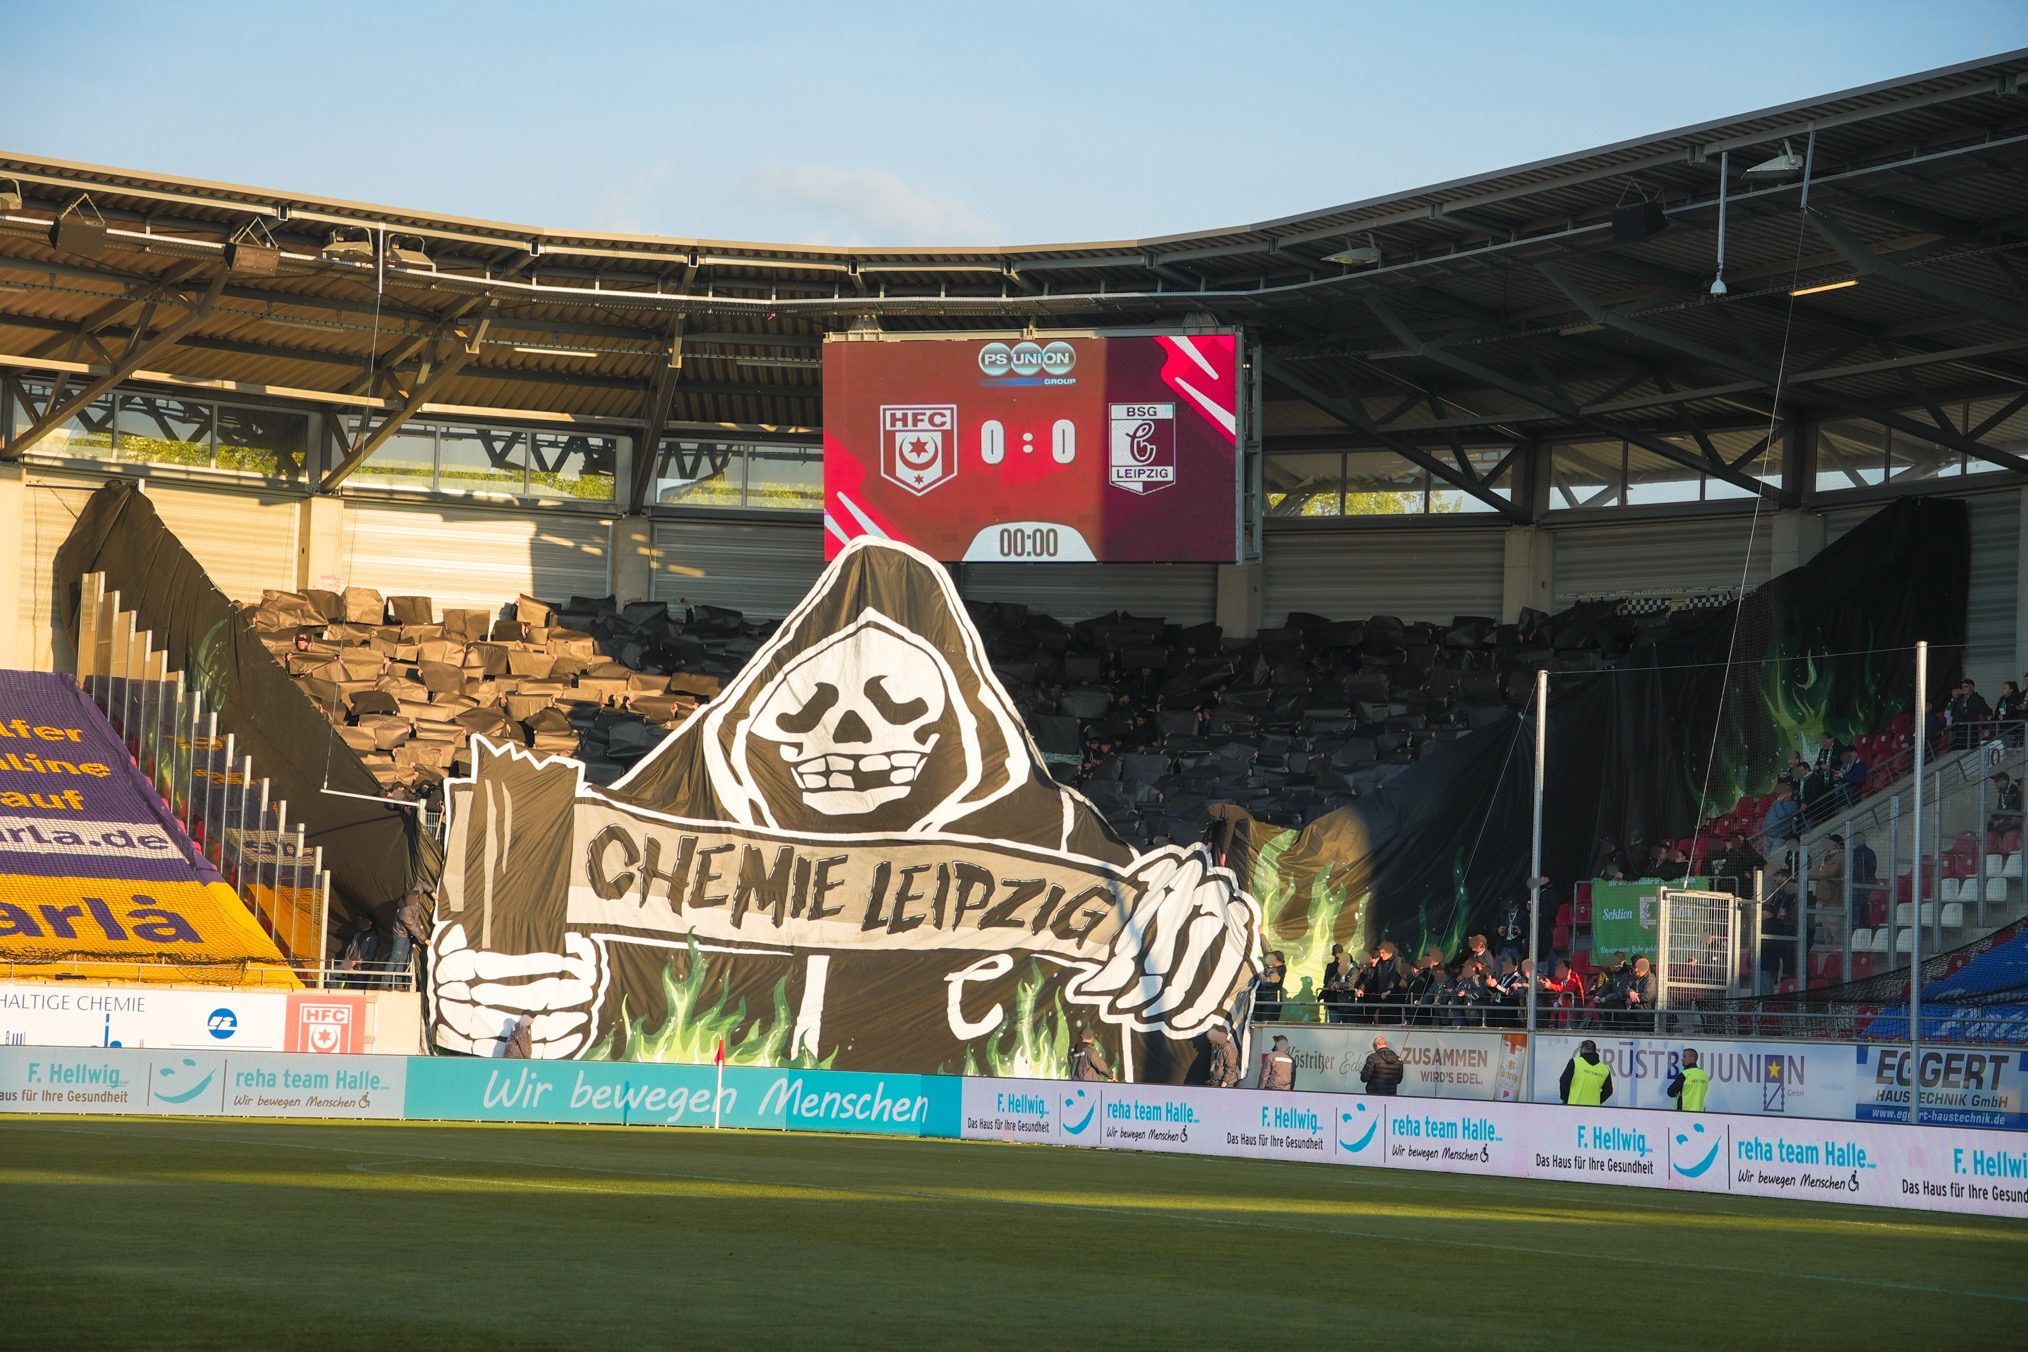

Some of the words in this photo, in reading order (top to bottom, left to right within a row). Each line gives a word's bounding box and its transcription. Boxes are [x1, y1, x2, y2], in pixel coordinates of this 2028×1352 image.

[984, 353, 1008, 365] PS
[1012, 352, 1070, 365] UNION
[890, 412, 947, 428] HFC
[1126, 406, 1157, 417] BSG
[1116, 468, 1168, 478] LEIPZIG
[999, 528, 1058, 557] 00:00
[586, 823, 849, 930] CHEMIE
[861, 860, 1117, 950] LEIPZIG
[1603, 908, 1632, 920] Sektion
[77, 996, 145, 1012] CHEMIE
[306, 1010, 346, 1022] HFC
[1340, 1051, 1363, 1075] Ede
[1402, 1047, 1488, 1068] ZUSAMMEN
[28, 1063, 42, 1083] F.
[50, 1063, 120, 1089] Hellwig
[235, 1068, 276, 1088] reha
[283, 1069, 329, 1090] team
[335, 1070, 380, 1090] Halle
[1420, 1070, 1453, 1084] WIRD'S
[1457, 1072, 1483, 1085] EDEL.
[1876, 1050, 2010, 1091] EGGERT
[21, 1089, 38, 1101] für
[42, 1090, 63, 1102] Ihre
[67, 1090, 128, 1103] Gesundheit
[234, 1095, 253, 1106] Wir
[258, 1095, 300, 1109] bewegen
[305, 1096, 356, 1109] Menschen
[483, 1067, 552, 1109] Wir
[570, 1070, 737, 1123] bewegen
[758, 1077, 929, 1123] Menschen
[1876, 1090, 1968, 1107] HAUSECHNIK
[1971, 1095, 2008, 1109] GmbH
[998, 1093, 1005, 1112] F.
[1008, 1093, 1044, 1119] Hellwig
[1107, 1099, 1131, 1119] reha
[1134, 1100, 1162, 1121] team
[1166, 1101, 1194, 1123] Halle
[1872, 1108, 2006, 1125] www.eggrt-haustechnik.de
[968, 1117, 978, 1129] Das
[979, 1118, 993, 1130] Haus
[995, 1119, 1003, 1130] für
[1004, 1120, 1016, 1131] Ihre
[1018, 1120, 1050, 1133] Gesundheit
[1262, 1106, 1270, 1127] F.
[1274, 1107, 1317, 1135] Hellwig
[1392, 1114, 1420, 1136] reha
[1425, 1115, 1458, 1139] team
[1462, 1117, 1496, 1141] Halle
[1107, 1126, 1118, 1138] Wir
[1120, 1126, 1146, 1142] bewegen
[1148, 1129, 1179, 1141] Menschen
[1227, 1132, 1239, 1145] Das
[1241, 1133, 1257, 1146] Haus
[1259, 1134, 1268, 1146] für
[1271, 1135, 1284, 1148] Ihre
[1286, 1136, 1323, 1151] Gesundheit
[1577, 1125, 1588, 1148] F.
[1593, 1127, 1646, 1158] Hellwig
[1392, 1144, 1405, 1156] Wir
[1408, 1145, 1439, 1161] bewegen
[1441, 1147, 1479, 1161] Menschen
[1738, 1136, 1773, 1161] reha
[1778, 1138, 1819, 1165] team
[1825, 1141, 1867, 1168] Halle
[1536, 1153, 1550, 1168] Das
[1552, 1155, 1571, 1169] Haus
[1574, 1156, 1585, 1170] für
[1588, 1157, 1605, 1172] Ihre
[1607, 1159, 1653, 1175] Gesundheit
[1954, 1148, 1967, 1174] F.
[1973, 1149, 2028, 1178] Hellwi
[1738, 1169, 1754, 1182] Wir
[1758, 1170, 1796, 1188] bewegen
[1800, 1173, 1846, 1190] Menschen
[1902, 1179, 1920, 1195] Das
[1923, 1180, 1947, 1197] Haus
[1950, 1182, 1965, 1198] für
[1968, 1184, 1989, 1200] Ihre
